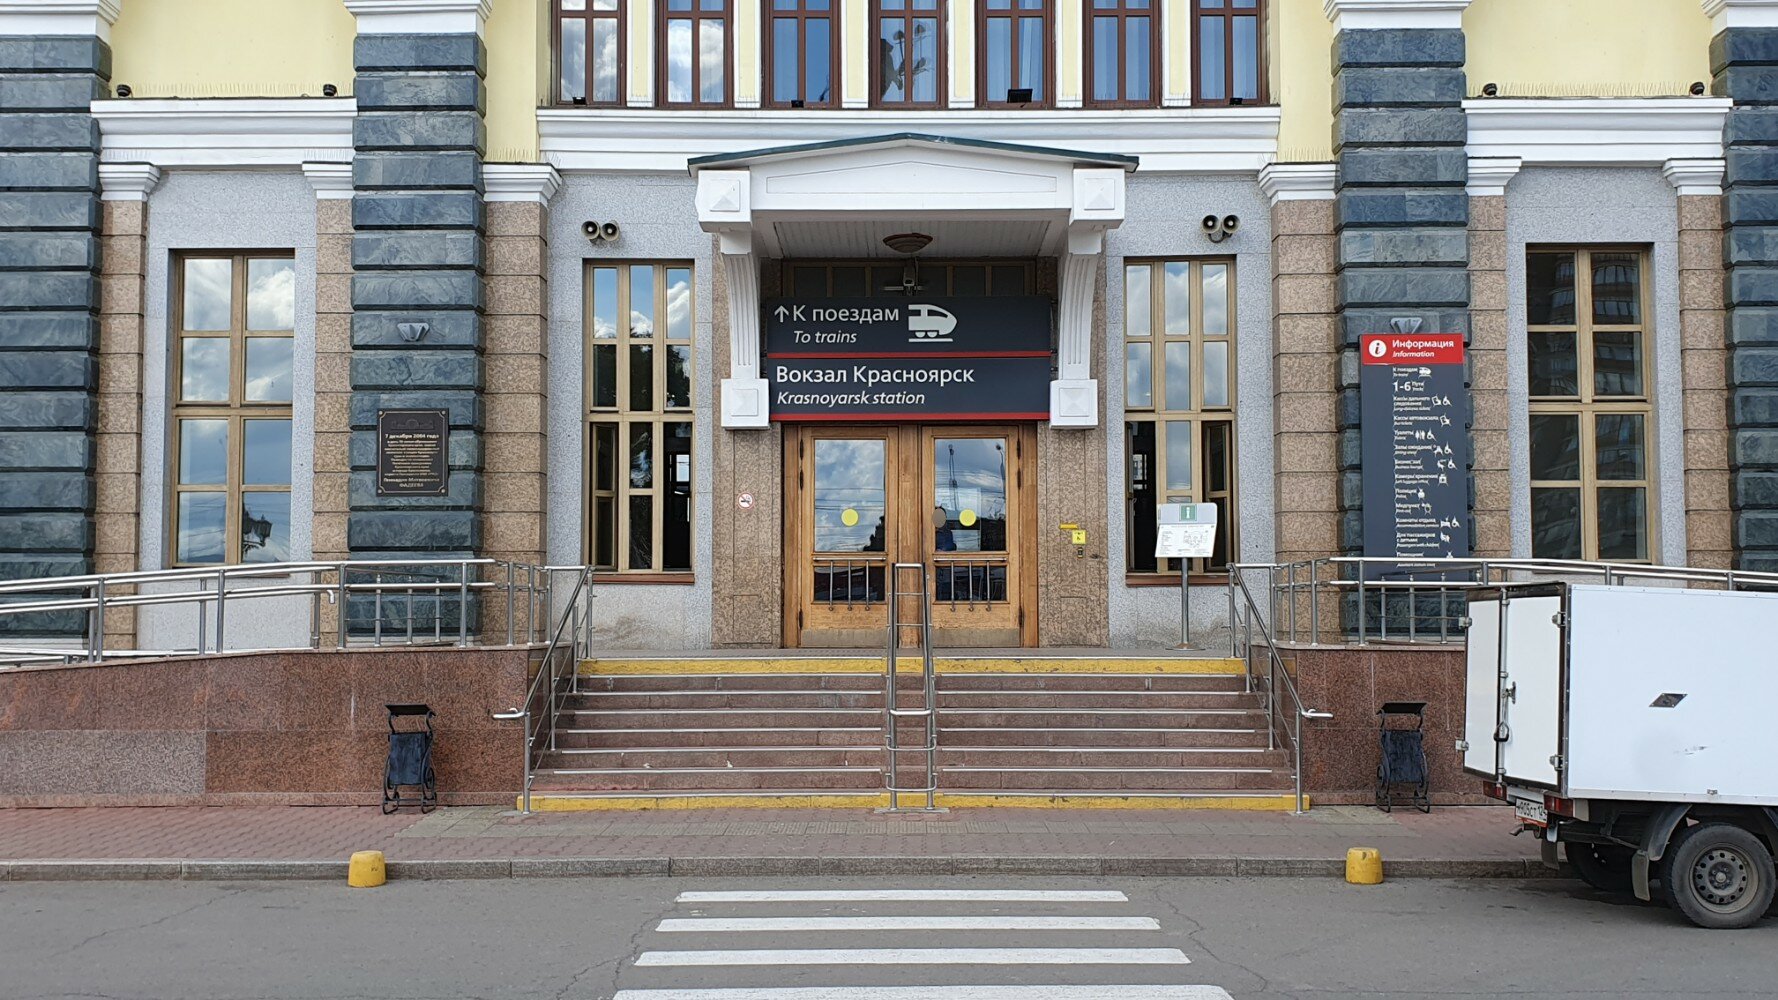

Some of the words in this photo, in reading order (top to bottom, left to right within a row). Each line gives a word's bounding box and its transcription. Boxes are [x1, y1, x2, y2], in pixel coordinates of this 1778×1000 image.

[793, 305, 806, 321] К
[812, 307, 899, 324] поездам
[794, 330, 811, 343] To
[815, 331, 857, 343] trains
[1392, 340, 1454, 350] Информация
[776, 366, 847, 383] Вокзал
[853, 366, 975, 387] Красноярск
[1393, 381, 1411, 392] 1-6
[777, 392, 870, 408] Krasnoyarsk
[873, 392, 925, 404] station
